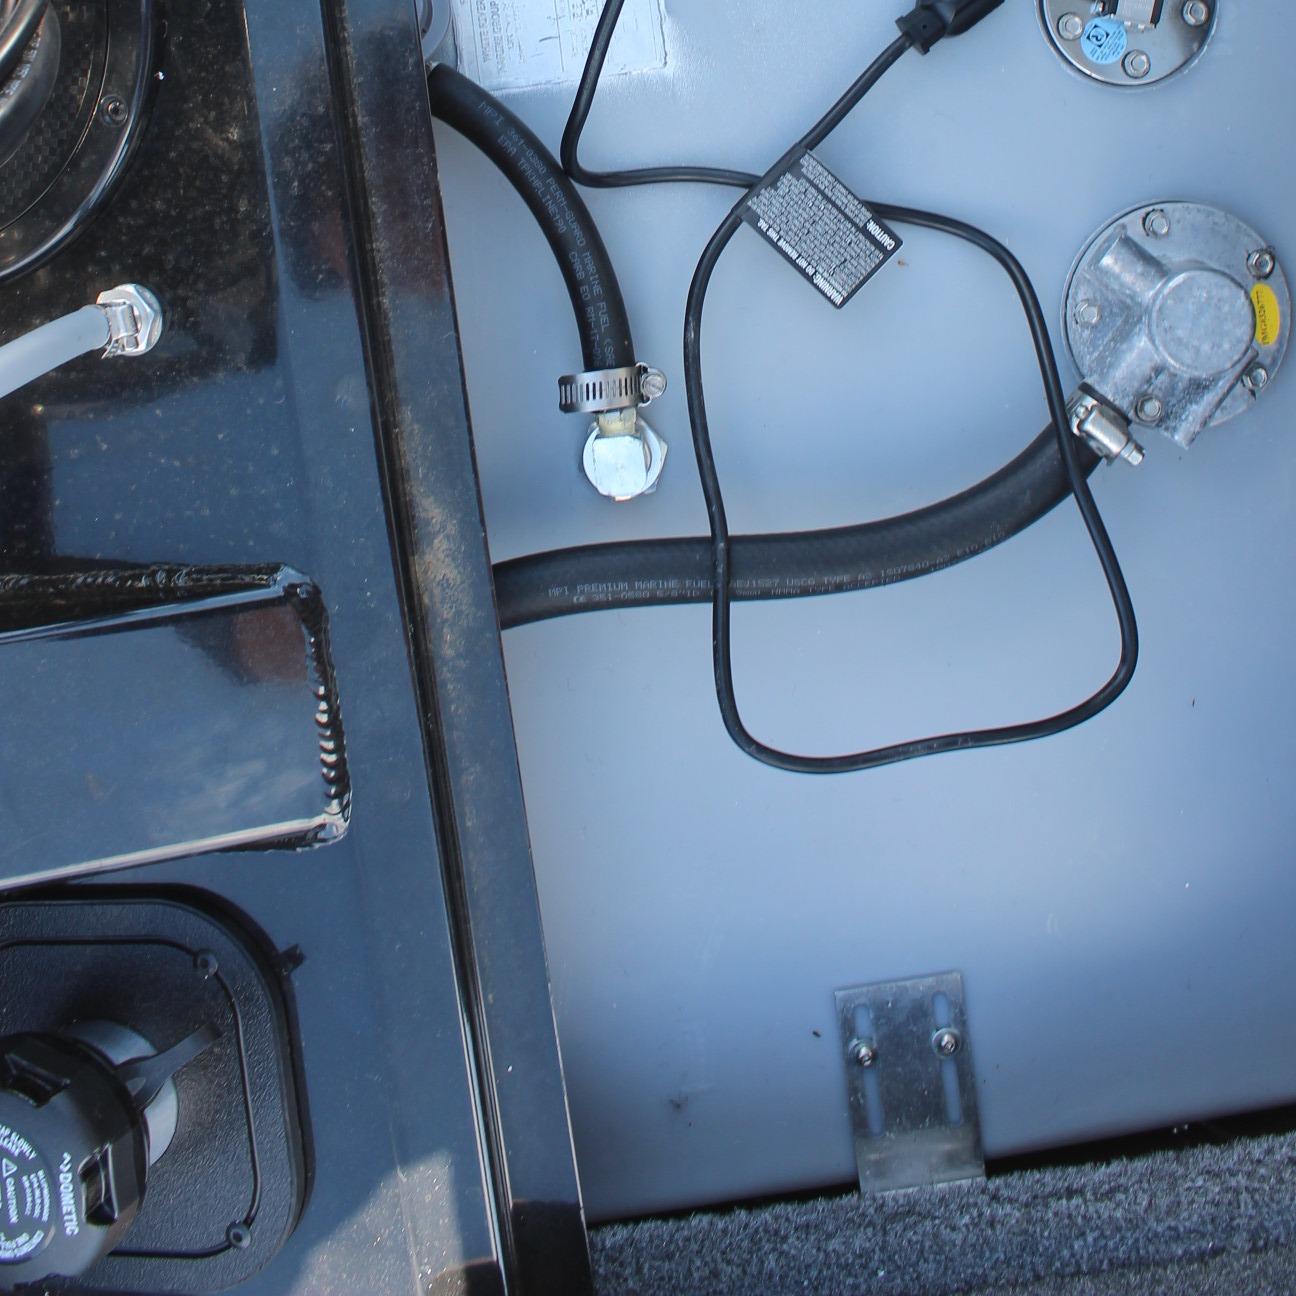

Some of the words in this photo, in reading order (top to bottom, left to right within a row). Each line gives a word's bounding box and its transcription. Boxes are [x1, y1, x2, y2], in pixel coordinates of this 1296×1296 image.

[765, 226, 781, 242] THIS
[863, 217, 896, 251] CAUTION:
[776, 236, 800, 260] REMOVE
[795, 254, 809, 269] NOT
[804, 263, 817, 276] DO
[810, 270, 845, 306] WARNING:
[590, 299, 615, 333] FUEL
[575, 579, 629, 594] PREMIUM
[634, 577, 681, 591] MARINE
[59, 1171, 80, 1237] DOMETIC
